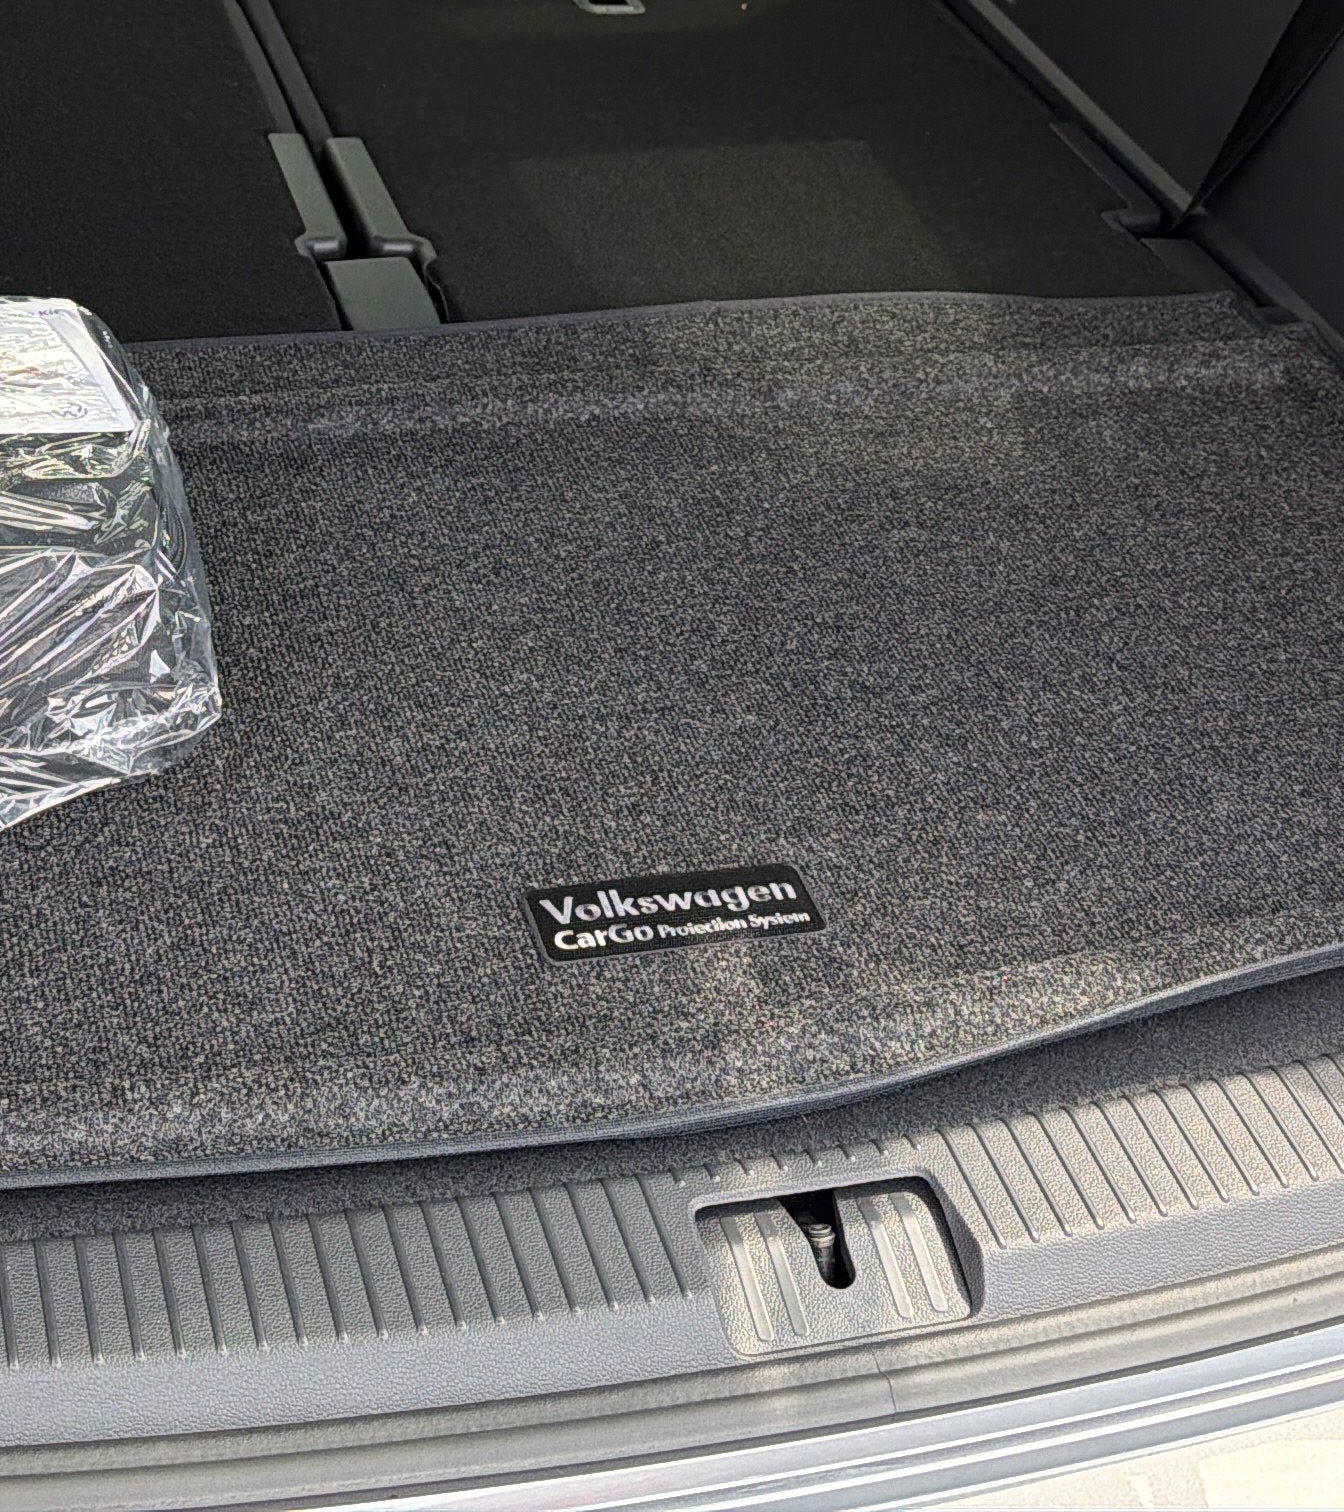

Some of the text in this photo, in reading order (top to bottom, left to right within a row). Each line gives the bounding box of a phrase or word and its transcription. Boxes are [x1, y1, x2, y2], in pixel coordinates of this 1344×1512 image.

[538, 881, 797, 925] Volkswagen
[553, 911, 811, 950] CarGo Protection System
